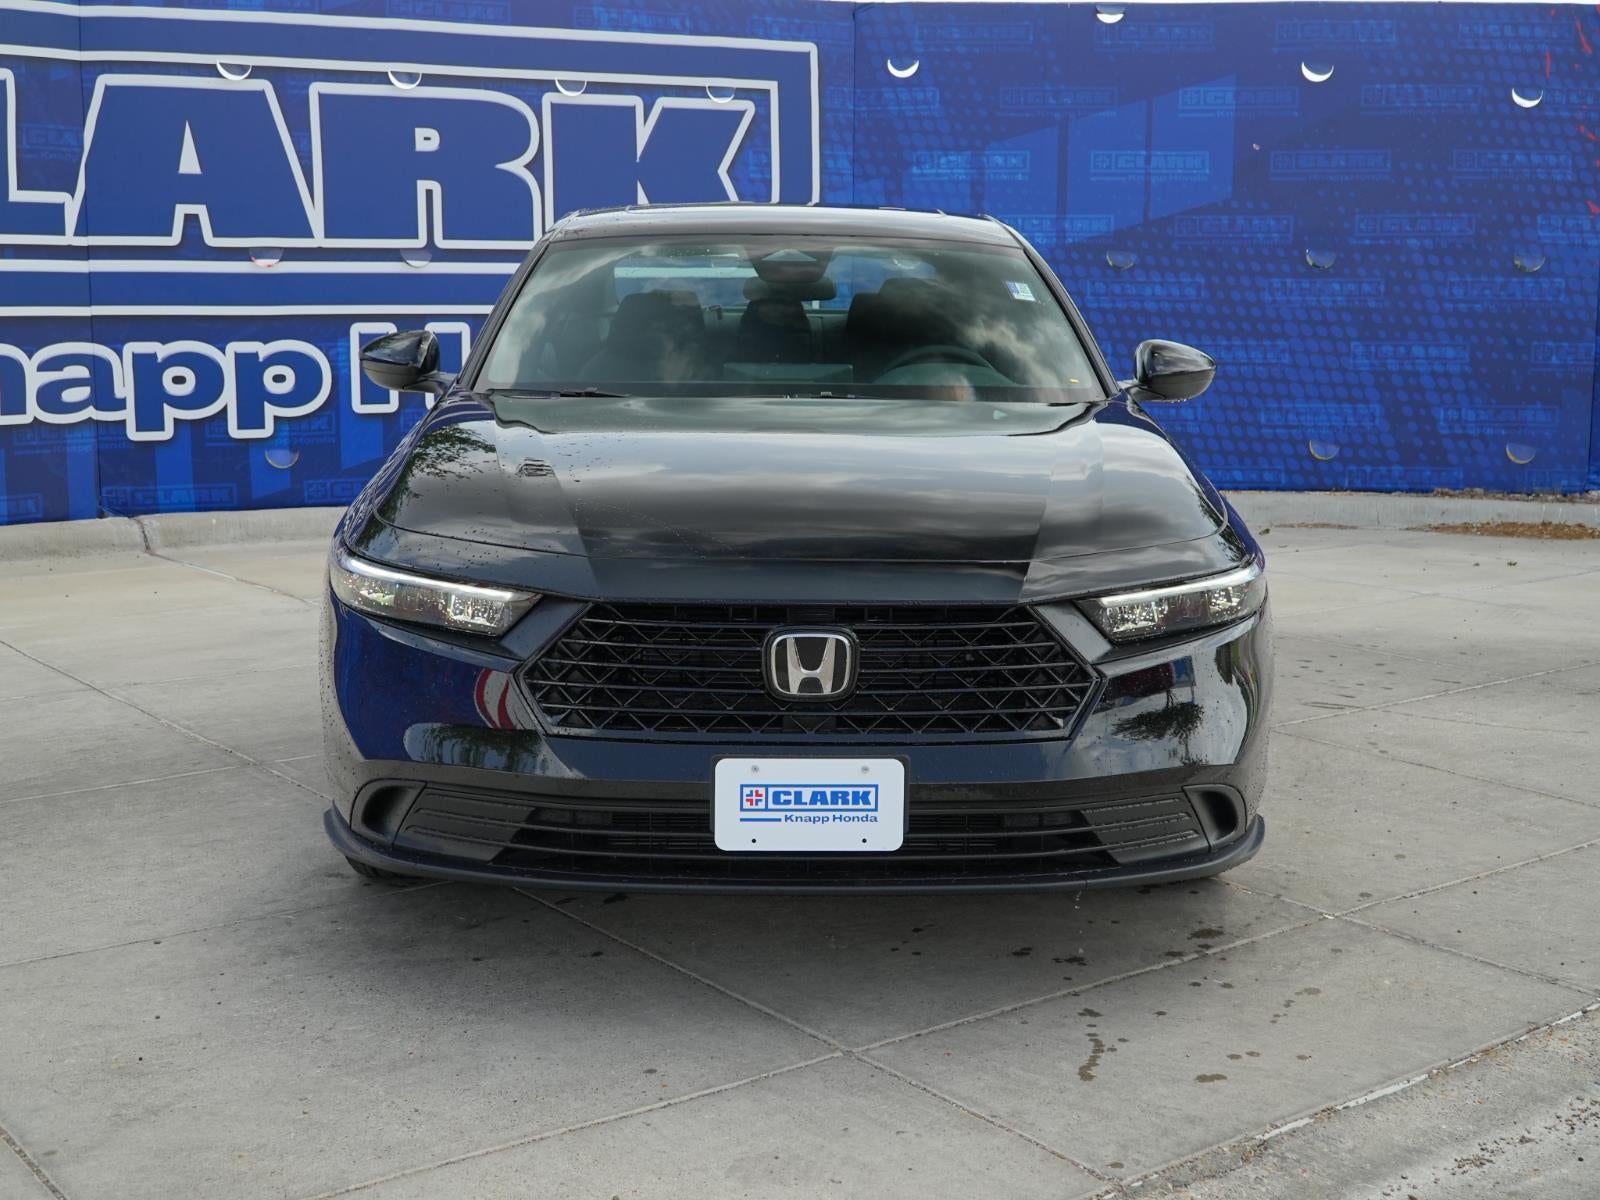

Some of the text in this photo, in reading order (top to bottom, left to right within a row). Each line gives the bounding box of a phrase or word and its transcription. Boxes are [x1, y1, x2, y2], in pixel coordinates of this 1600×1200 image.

[772, 790, 872, 806] CLARK
[784, 814, 878, 825] Knapp Honda
